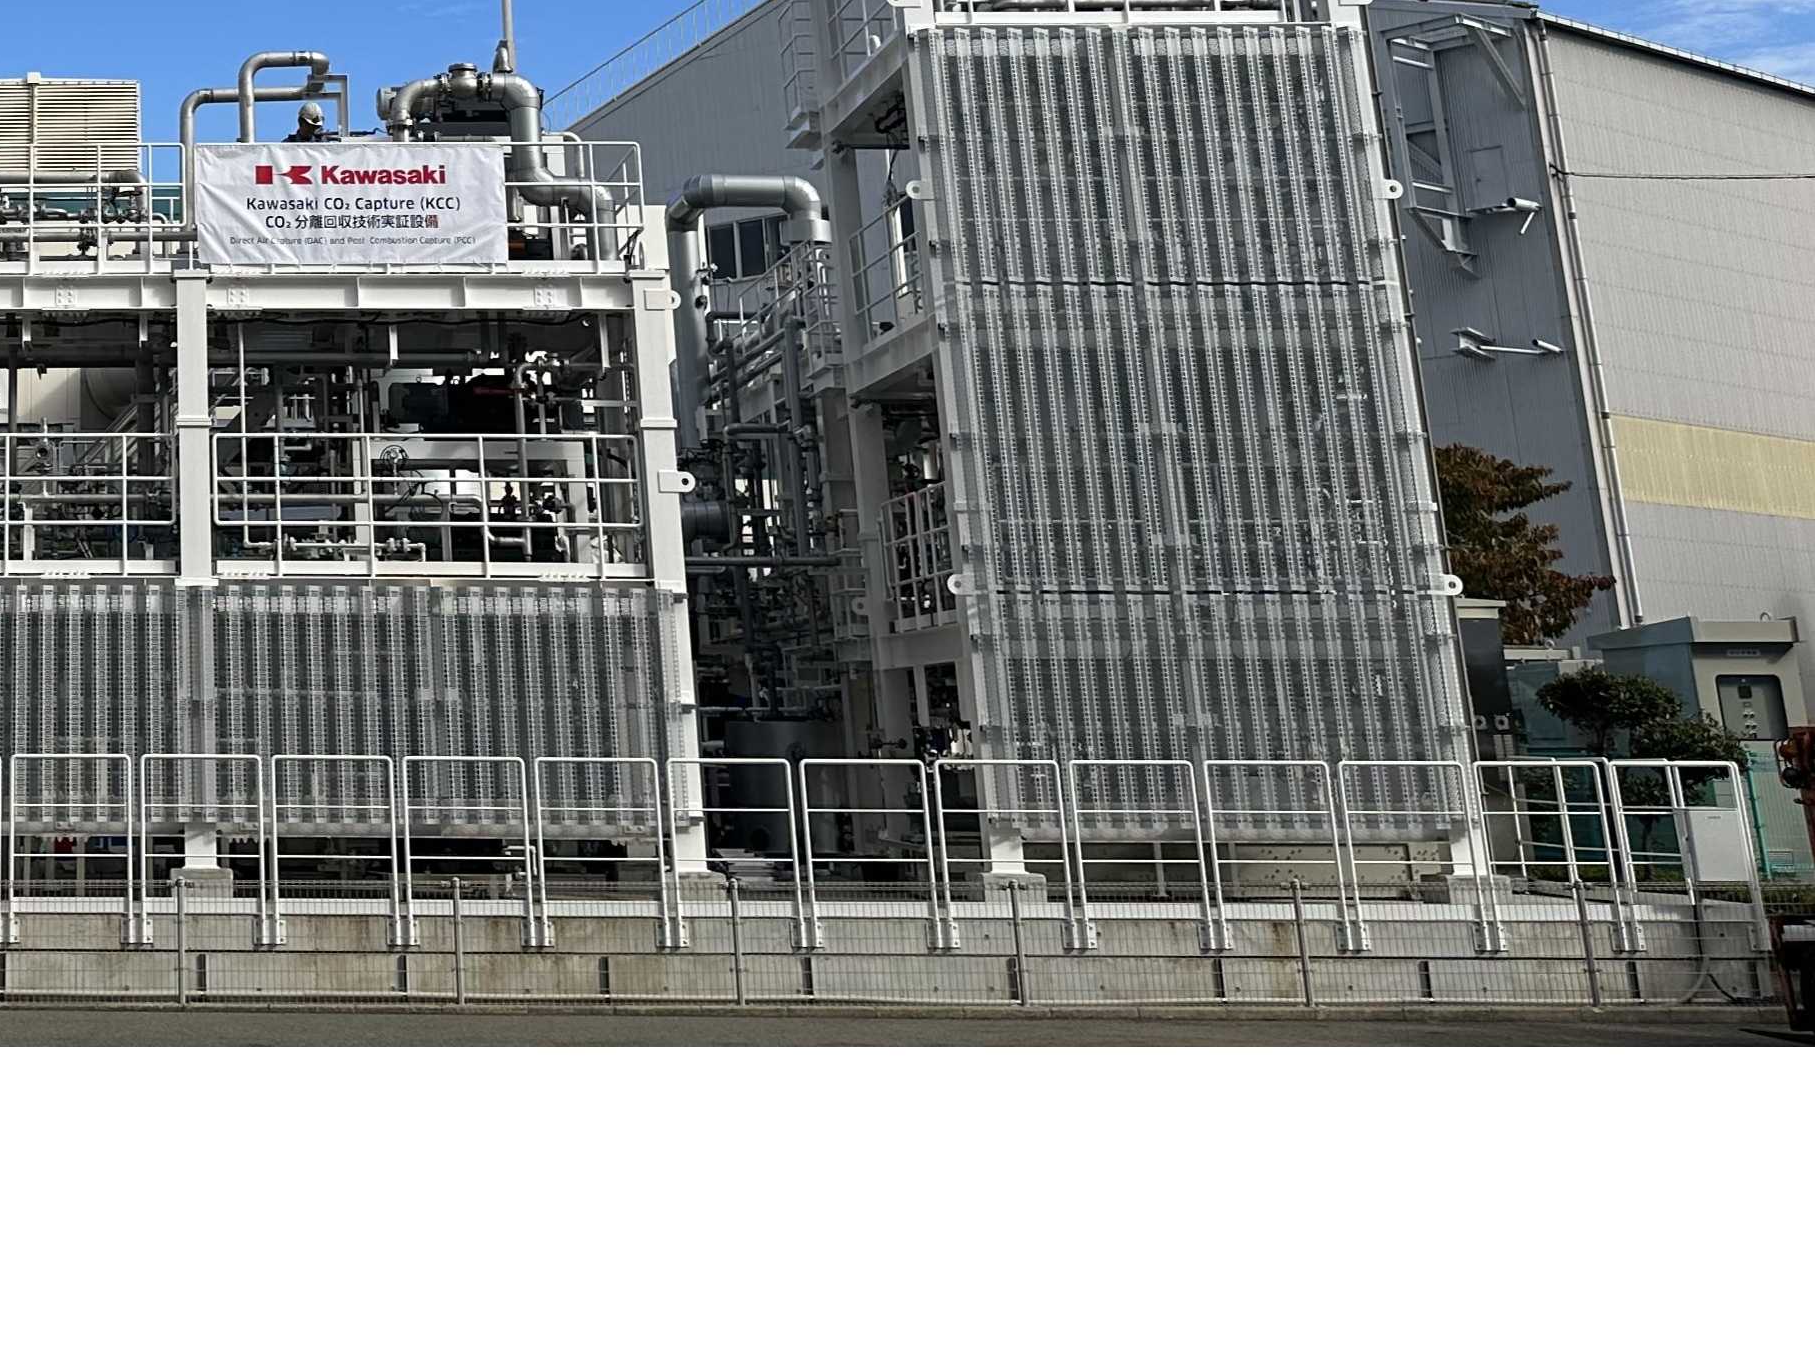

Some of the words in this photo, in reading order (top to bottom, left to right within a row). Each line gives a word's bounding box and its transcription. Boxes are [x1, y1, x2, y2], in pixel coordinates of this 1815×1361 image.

[321, 165, 445, 185] Kawasaki
[246, 197, 319, 210] Kawasaki
[355, 197, 415, 211] Capture
[420, 196, 460, 211] (KCC)
